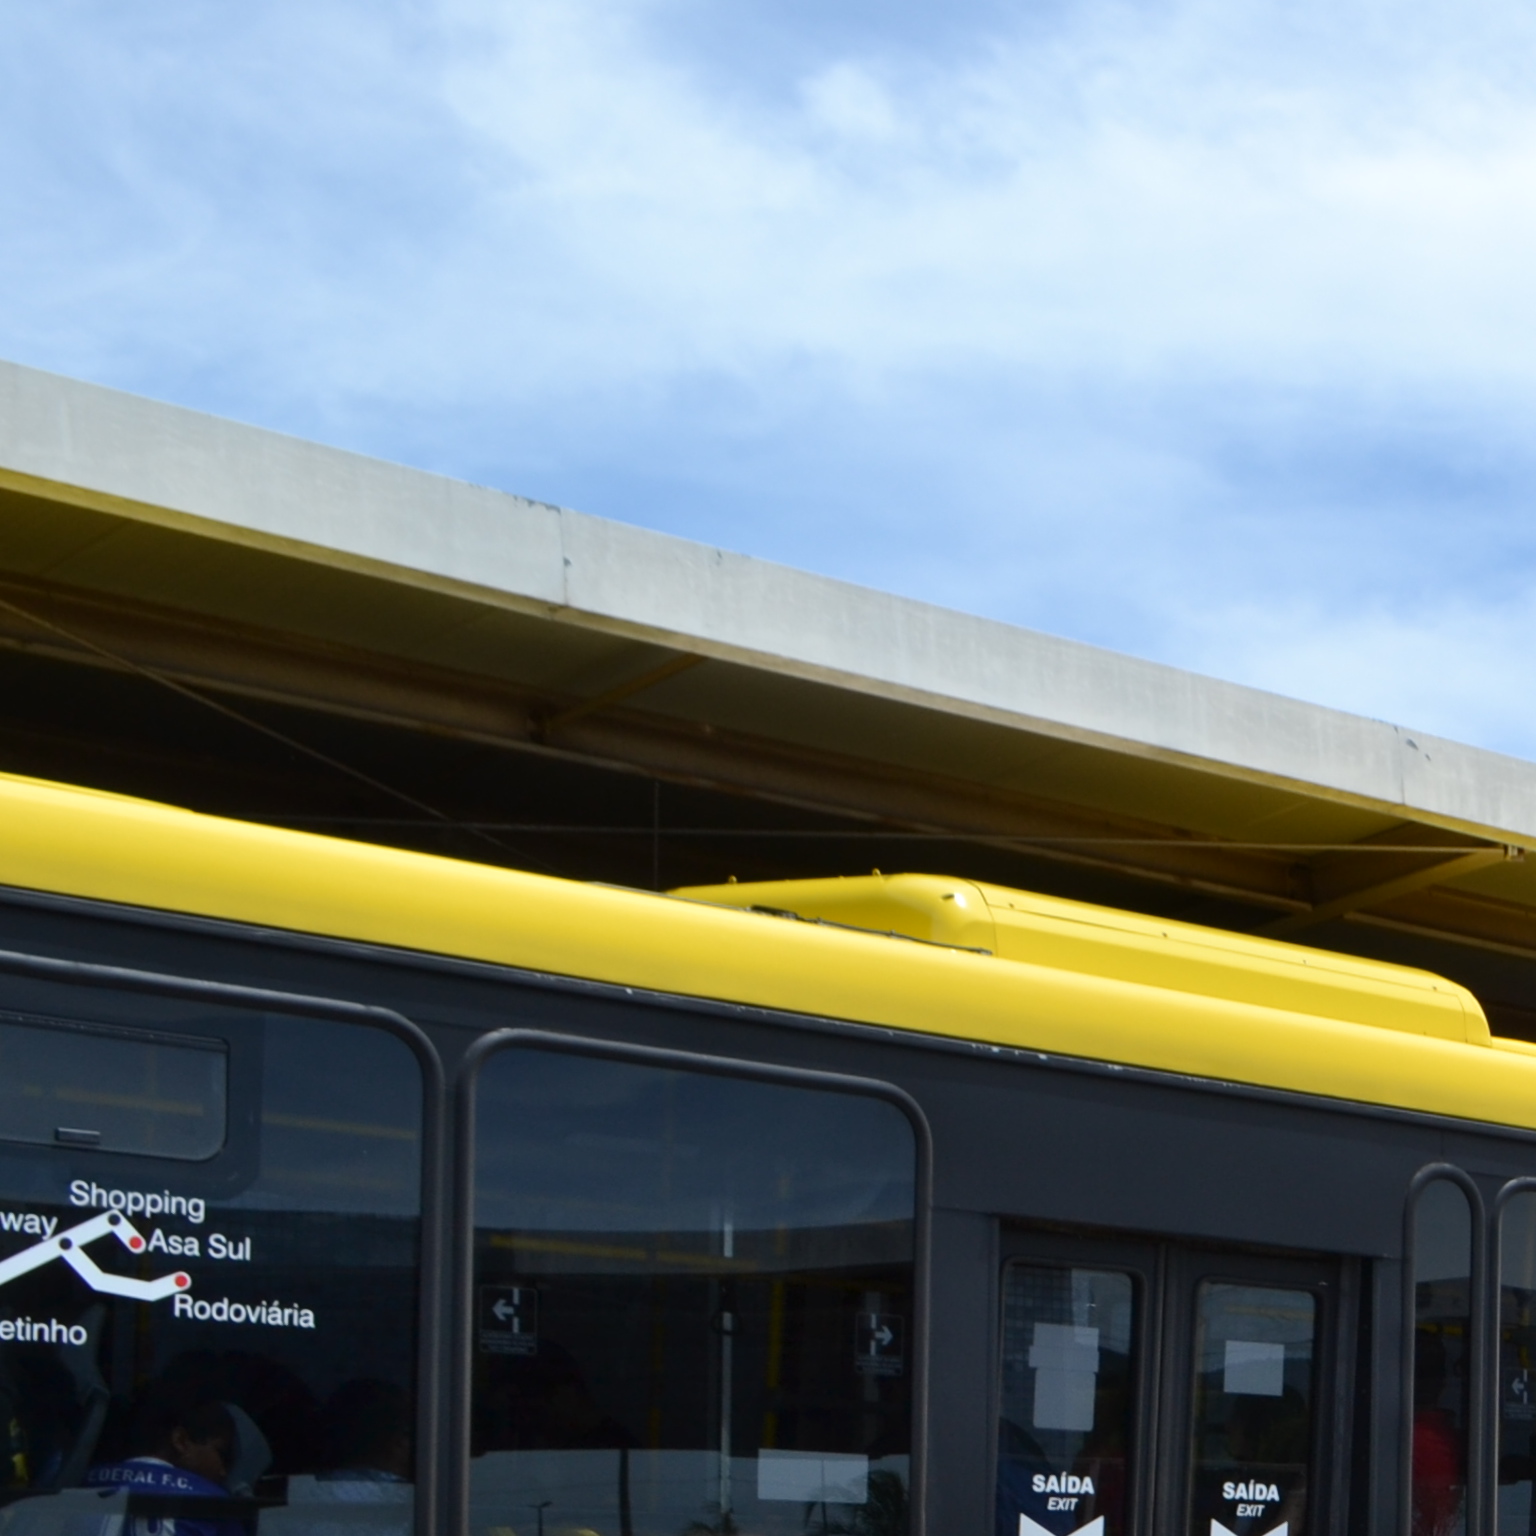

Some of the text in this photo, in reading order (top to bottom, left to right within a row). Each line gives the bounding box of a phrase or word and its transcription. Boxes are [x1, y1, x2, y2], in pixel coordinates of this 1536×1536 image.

[70, 1180, 206, 1223] Shopping
[0, 1211, 58, 1240] way
[149, 1228, 251, 1261] Asa Sul
[174, 1294, 316, 1328] Rodoviária
[0, 1316, 87, 1345] etinho
[88, 1467, 156, 1484] EDERAL
[1032, 1471, 1095, 1495] SAÍDA
[1222, 1479, 1280, 1502] SAÍDA
[1047, 1497, 1079, 1511] EXIT
[1236, 1503, 1265, 1517] EXIT
